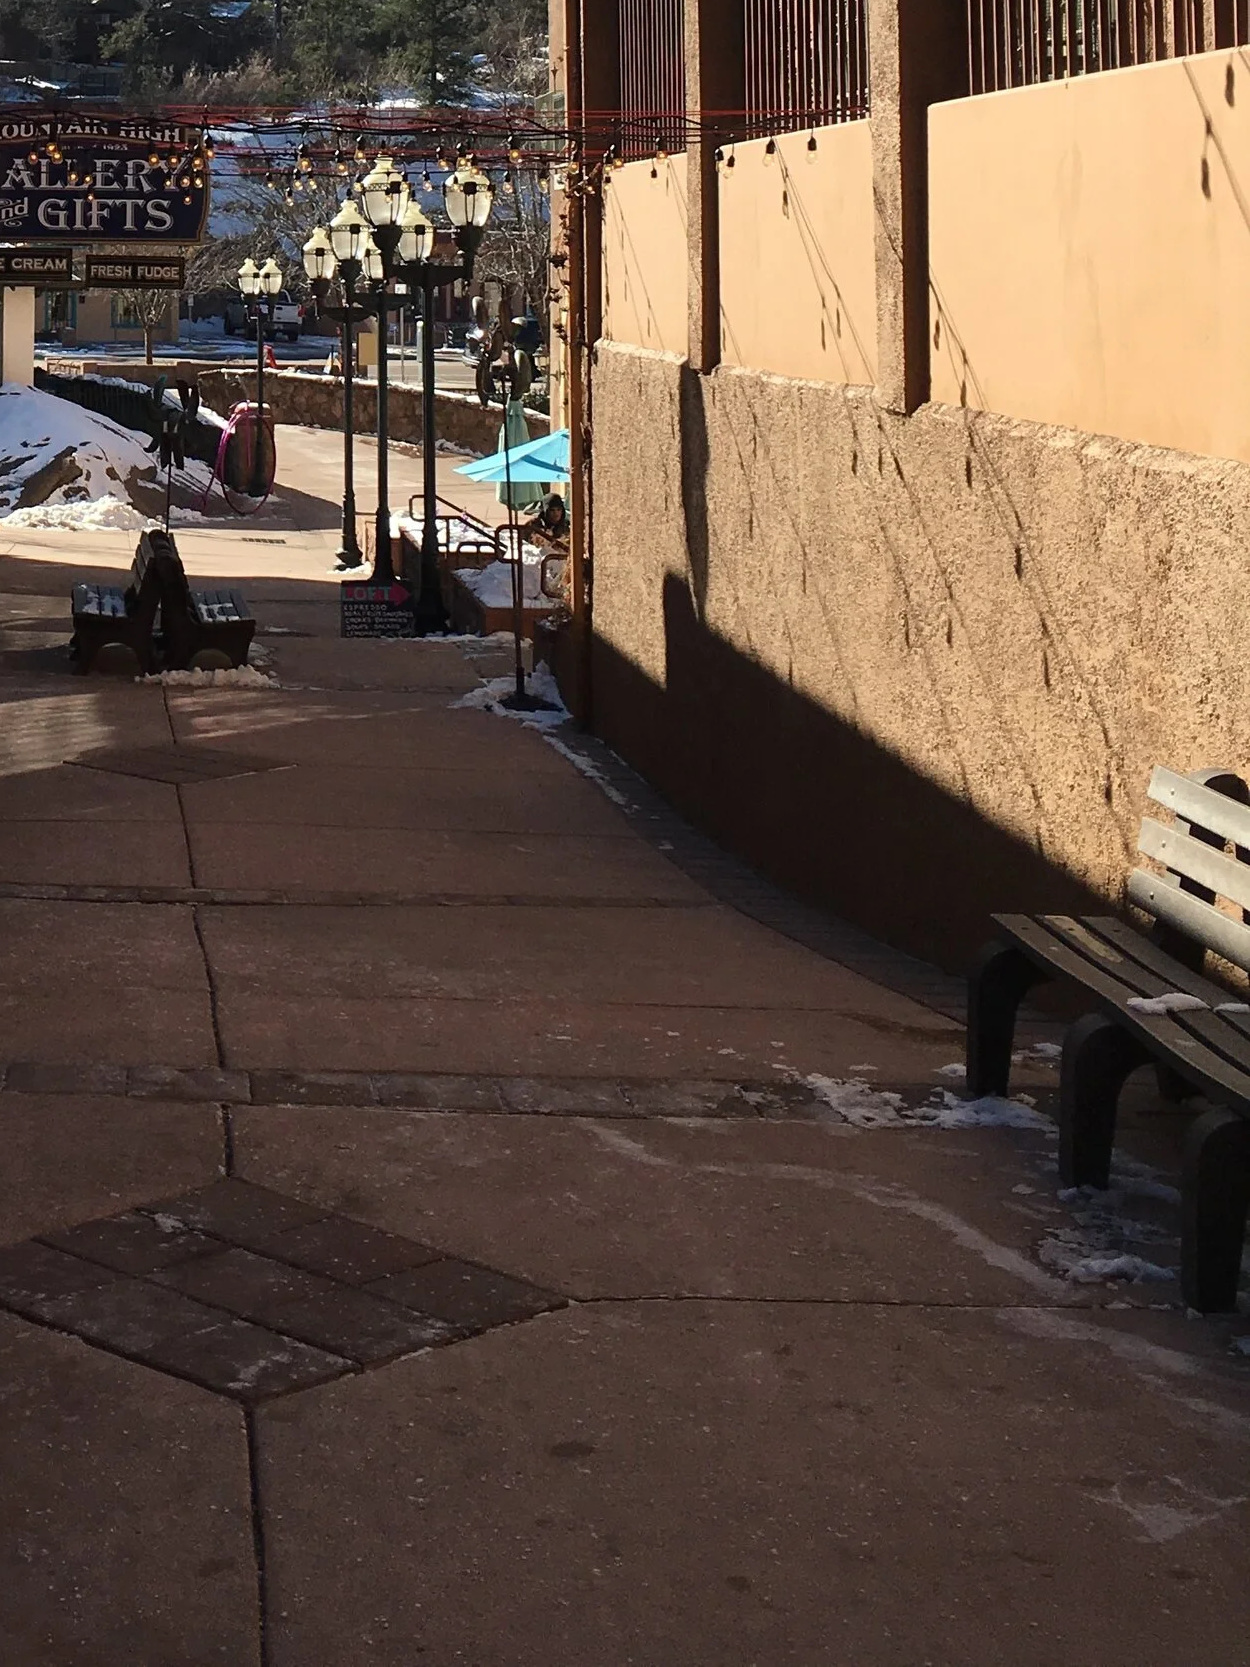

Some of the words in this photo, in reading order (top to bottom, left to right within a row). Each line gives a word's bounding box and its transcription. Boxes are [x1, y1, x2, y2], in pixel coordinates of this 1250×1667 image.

[119, 121, 181, 143] HIGH
[37, 198, 174, 231] GIFTS
[11, 257, 67, 271] CREAM
[90, 265, 132, 278] FRESH
[137, 266, 180, 279] FUDGE
[341, 586, 392, 602] LOFT
